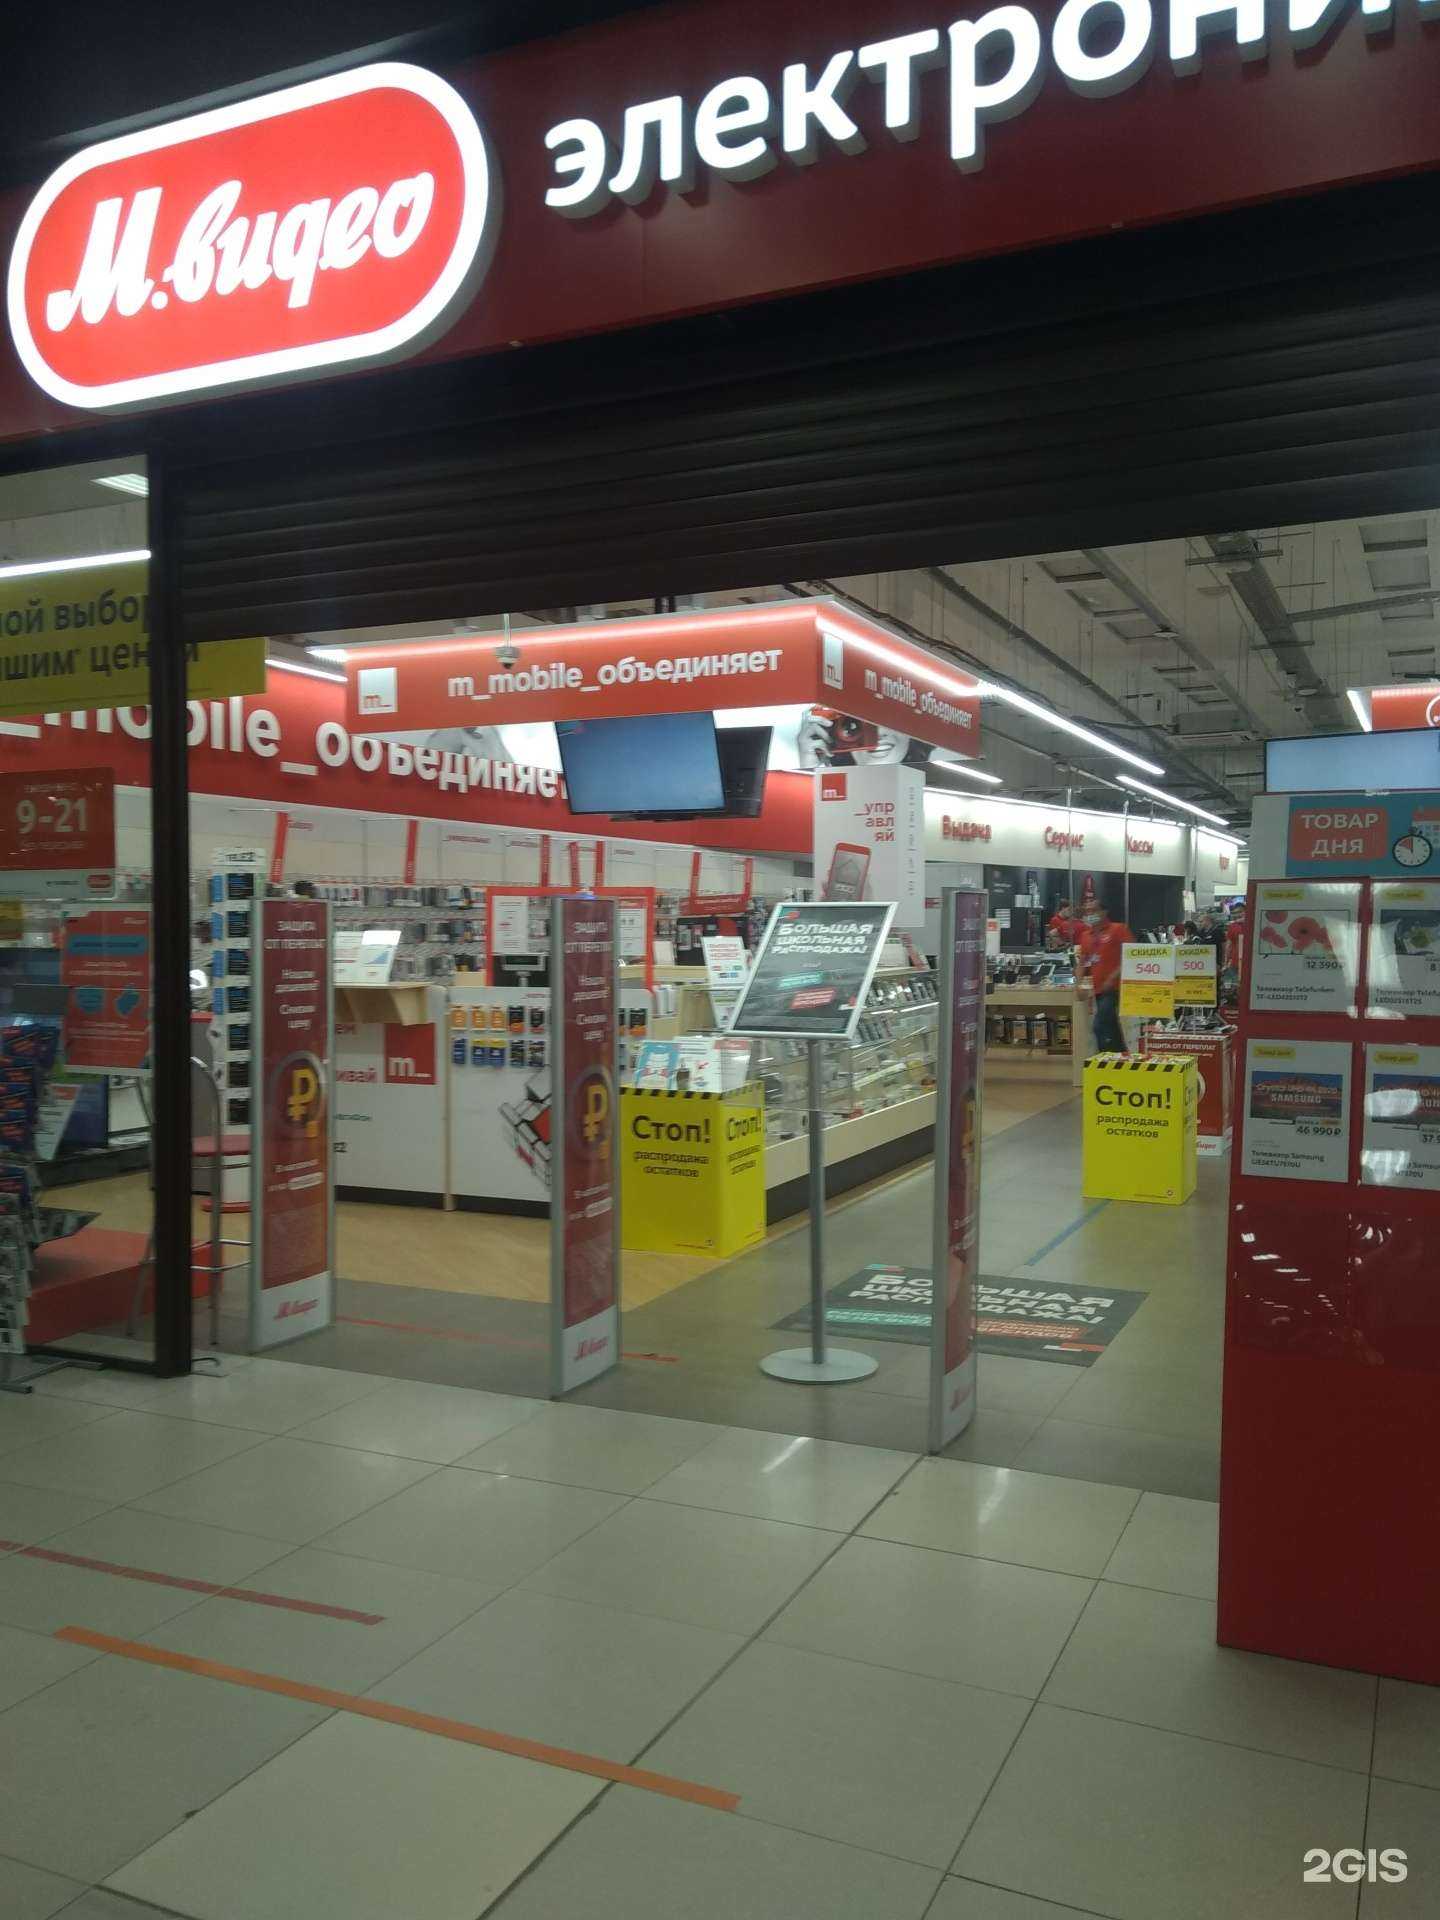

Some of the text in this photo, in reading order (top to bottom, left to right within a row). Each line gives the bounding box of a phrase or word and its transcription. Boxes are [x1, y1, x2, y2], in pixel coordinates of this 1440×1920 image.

[0, 598, 43, 637] ой
[448, 649, 783, 700] m_mobile_объединяет
[1302, 813, 1379, 829] ТОВАР
[1312, 838, 1364, 857] ДНЯ
[1135, 963, 1161, 974] 540
[1095, 1085, 1172, 1109] Стоп!
[632, 1115, 712, 1143] Стоп!
[1096, 1113, 1170, 1128] распродажа
[1106, 1126, 1159, 1138] остатков
[633, 1151, 709, 1166] распродажа
